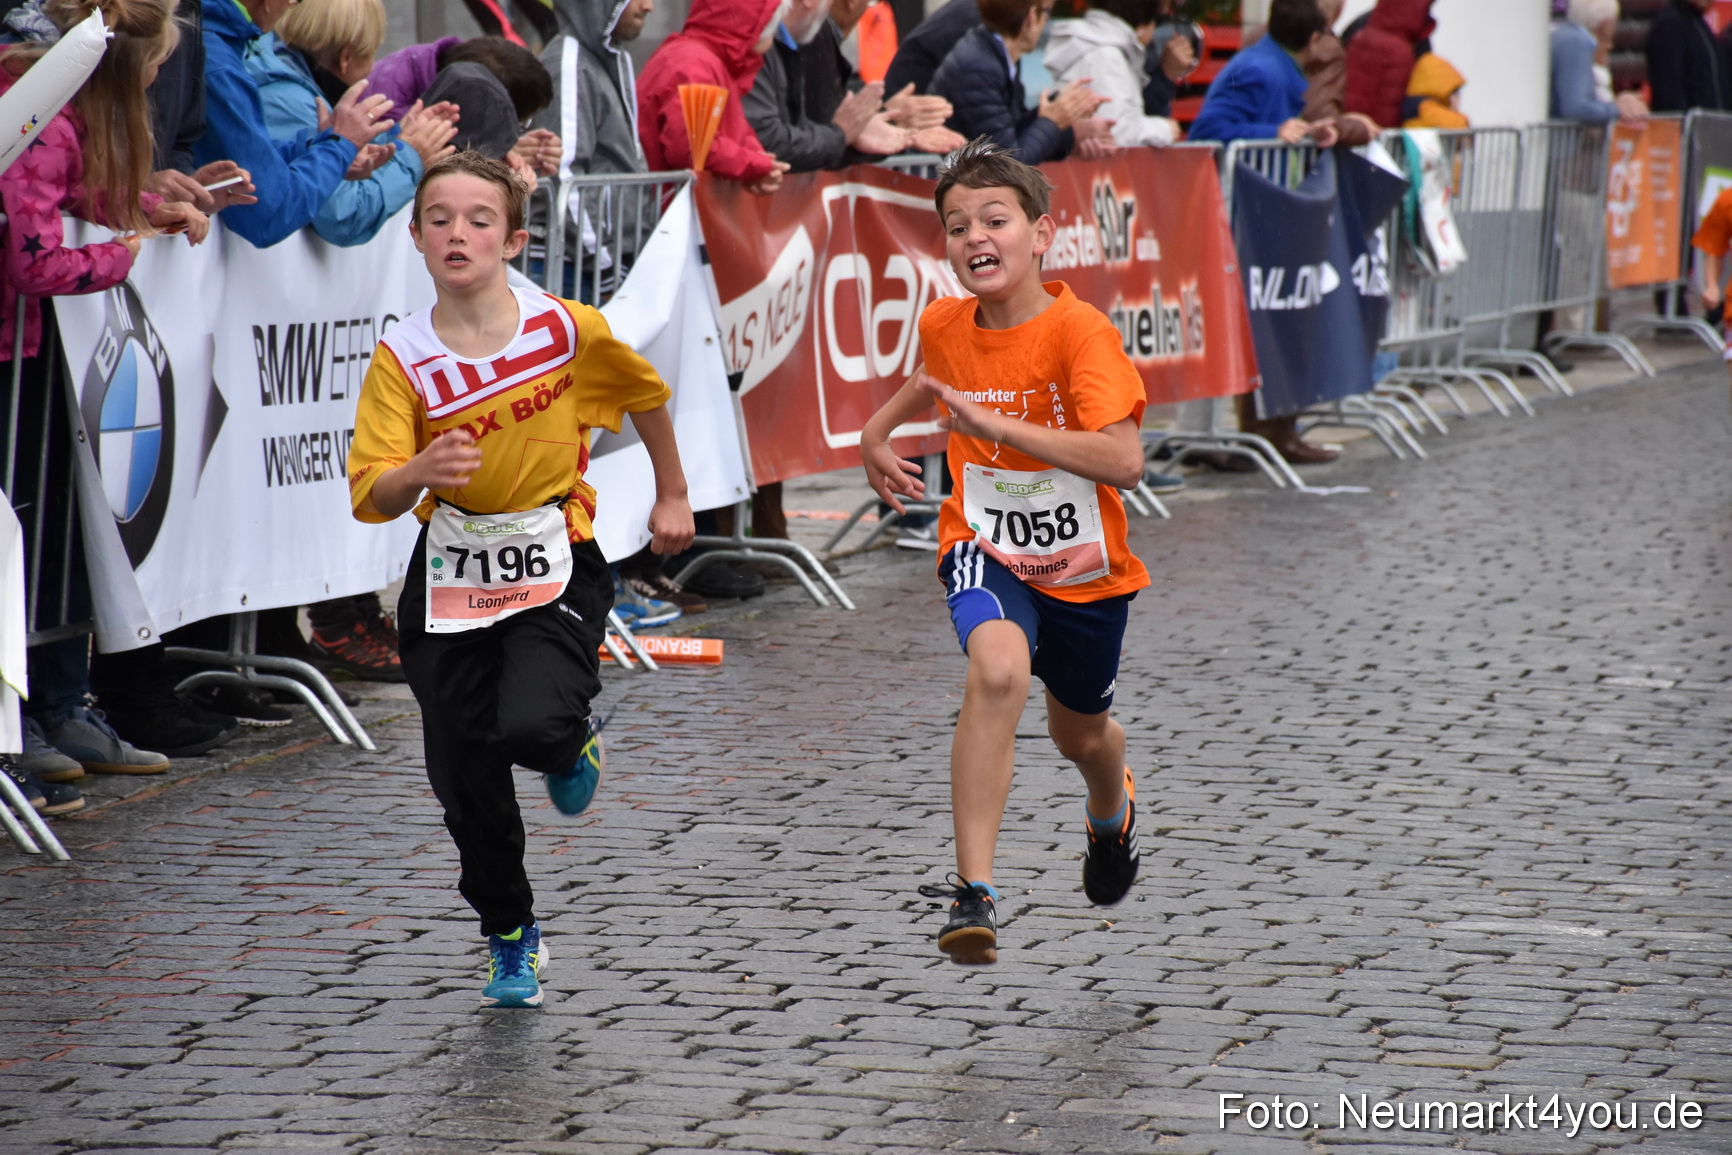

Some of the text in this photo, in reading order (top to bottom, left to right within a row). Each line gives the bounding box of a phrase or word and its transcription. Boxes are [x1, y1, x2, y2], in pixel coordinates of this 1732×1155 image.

[94, 286, 168, 384] BMW
[252, 322, 328, 407] BMW
[510, 372, 574, 423] BÖGL
[263, 431, 334, 488] WENIGER
[1007, 478, 1055, 495] BOCK
[984, 503, 1080, 548] 7058
[432, 573, 443, 581] B6
[446, 543, 550, 584] 7196
[1006, 558, 1069, 576] Johannes
